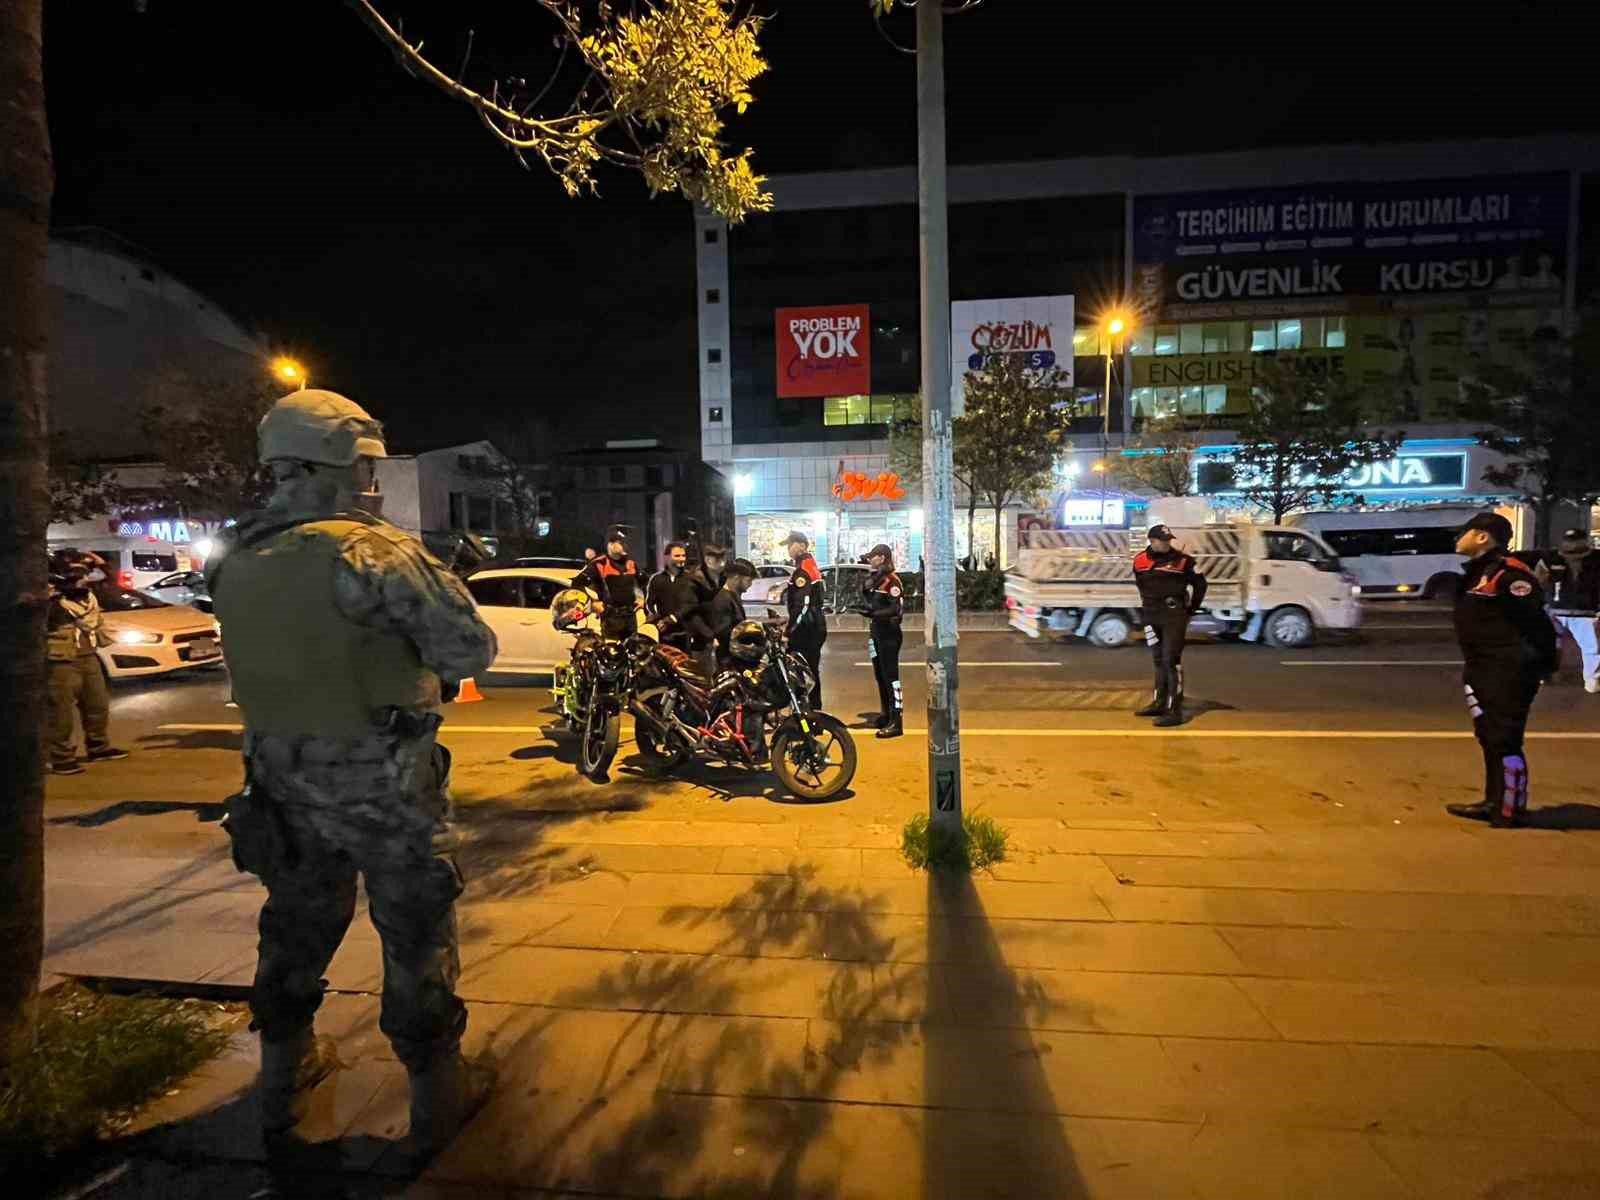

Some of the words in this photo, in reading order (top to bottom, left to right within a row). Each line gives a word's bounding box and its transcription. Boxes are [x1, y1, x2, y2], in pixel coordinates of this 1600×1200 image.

[1176, 200, 1274, 237] TERCİHİM
[1281, 194, 1353, 231] EĞİTİM
[1364, 194, 1510, 229] KURUMLARI
[1176, 259, 1344, 299] GÜVENLİK
[1380, 260, 1493, 291] KURSU
[790, 316, 860, 333] PROBLEM
[792, 330, 859, 360] YOK
[1149, 359, 1257, 384] ENGLISH
